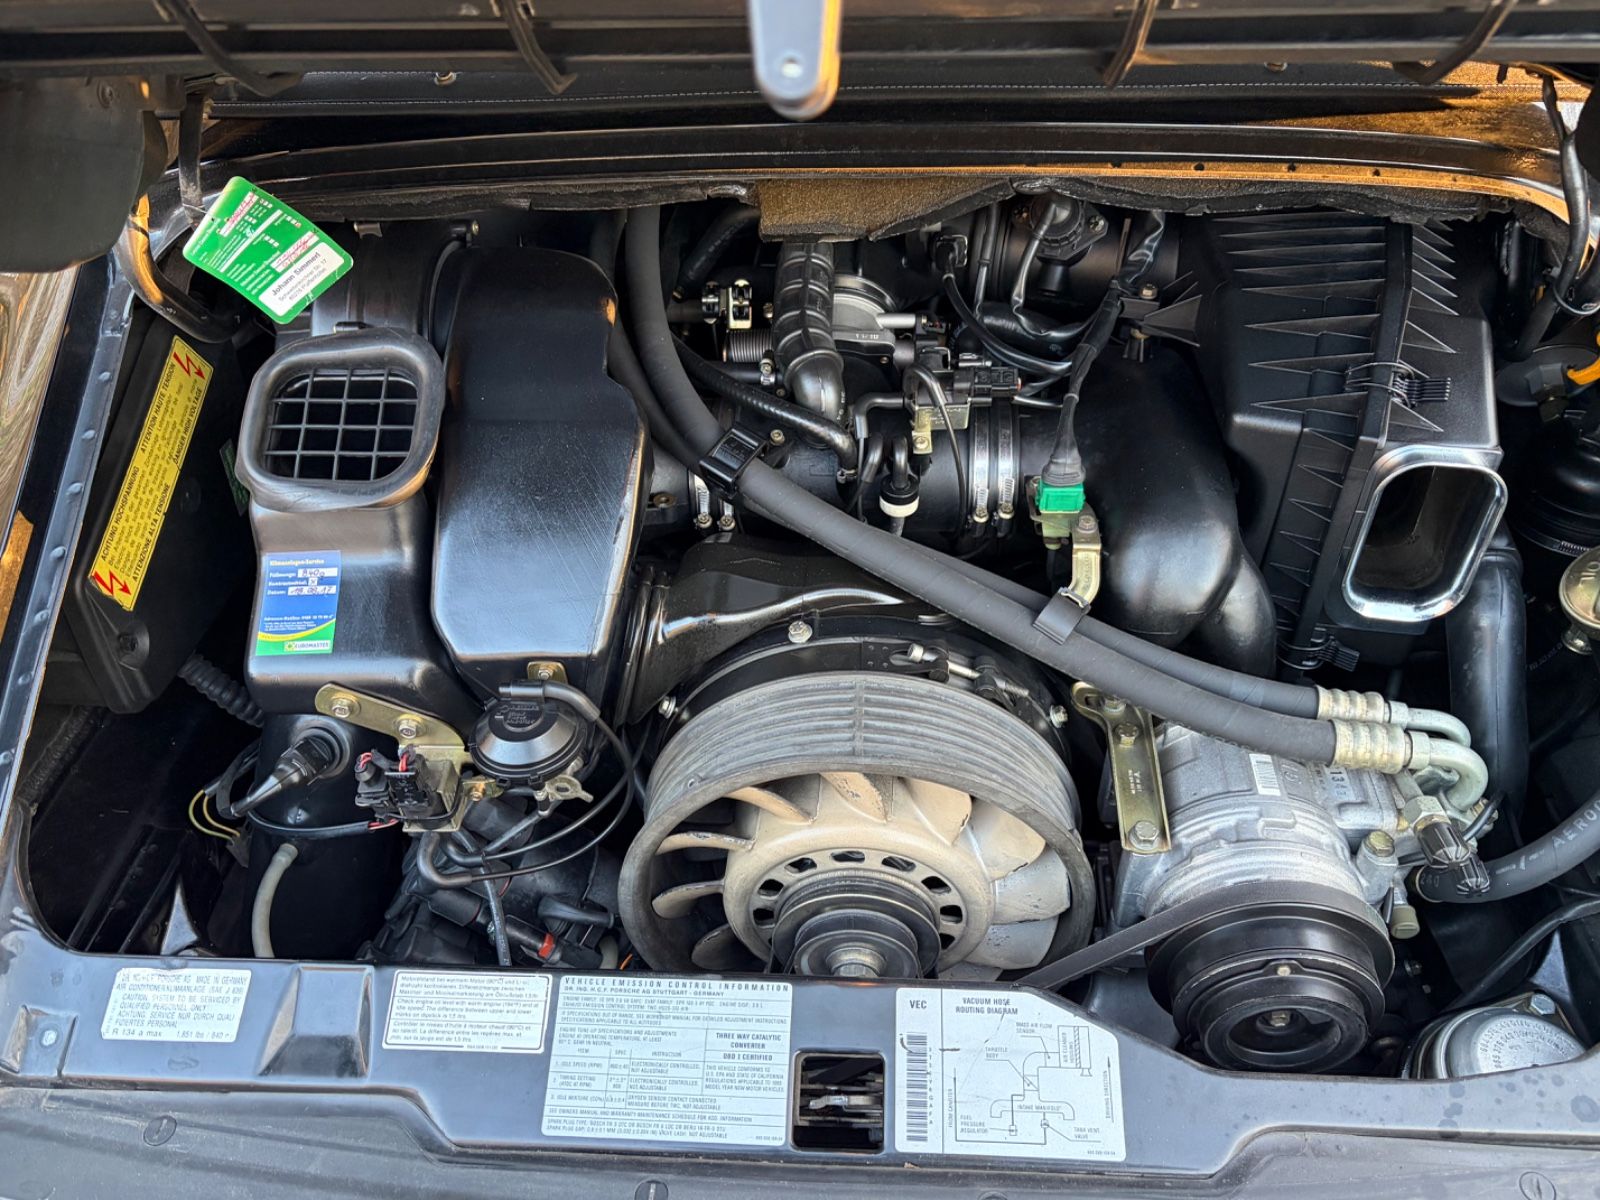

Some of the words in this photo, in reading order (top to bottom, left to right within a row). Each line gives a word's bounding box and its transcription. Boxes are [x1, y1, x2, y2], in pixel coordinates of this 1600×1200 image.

[140, 414, 158, 454] ATTENTION
[153, 390, 166, 416] HAUTE
[162, 361, 176, 392] TENSION
[172, 434, 186, 465] DANGER
[182, 416, 192, 435] HIGH
[188, 385, 202, 418] VOLTAGE
[101, 524, 118, 562] ACHTUNG
[114, 464, 139, 526] HOCHSPANNUNG
[131, 535, 152, 583] ATTENZIONE
[147, 515, 158, 537] ALTA
[154, 481, 170, 518] TENSIONE
[565, 977, 605, 985] VEHICLE
[612, 979, 661, 987] EMISSION
[668, 981, 713, 989] CONTROL
[719, 983, 788, 991] INFORMATION
[909, 1000, 927, 1009] VEC
[962, 997, 990, 1005] VACUUM
[993, 998, 1010, 1006] HOSE
